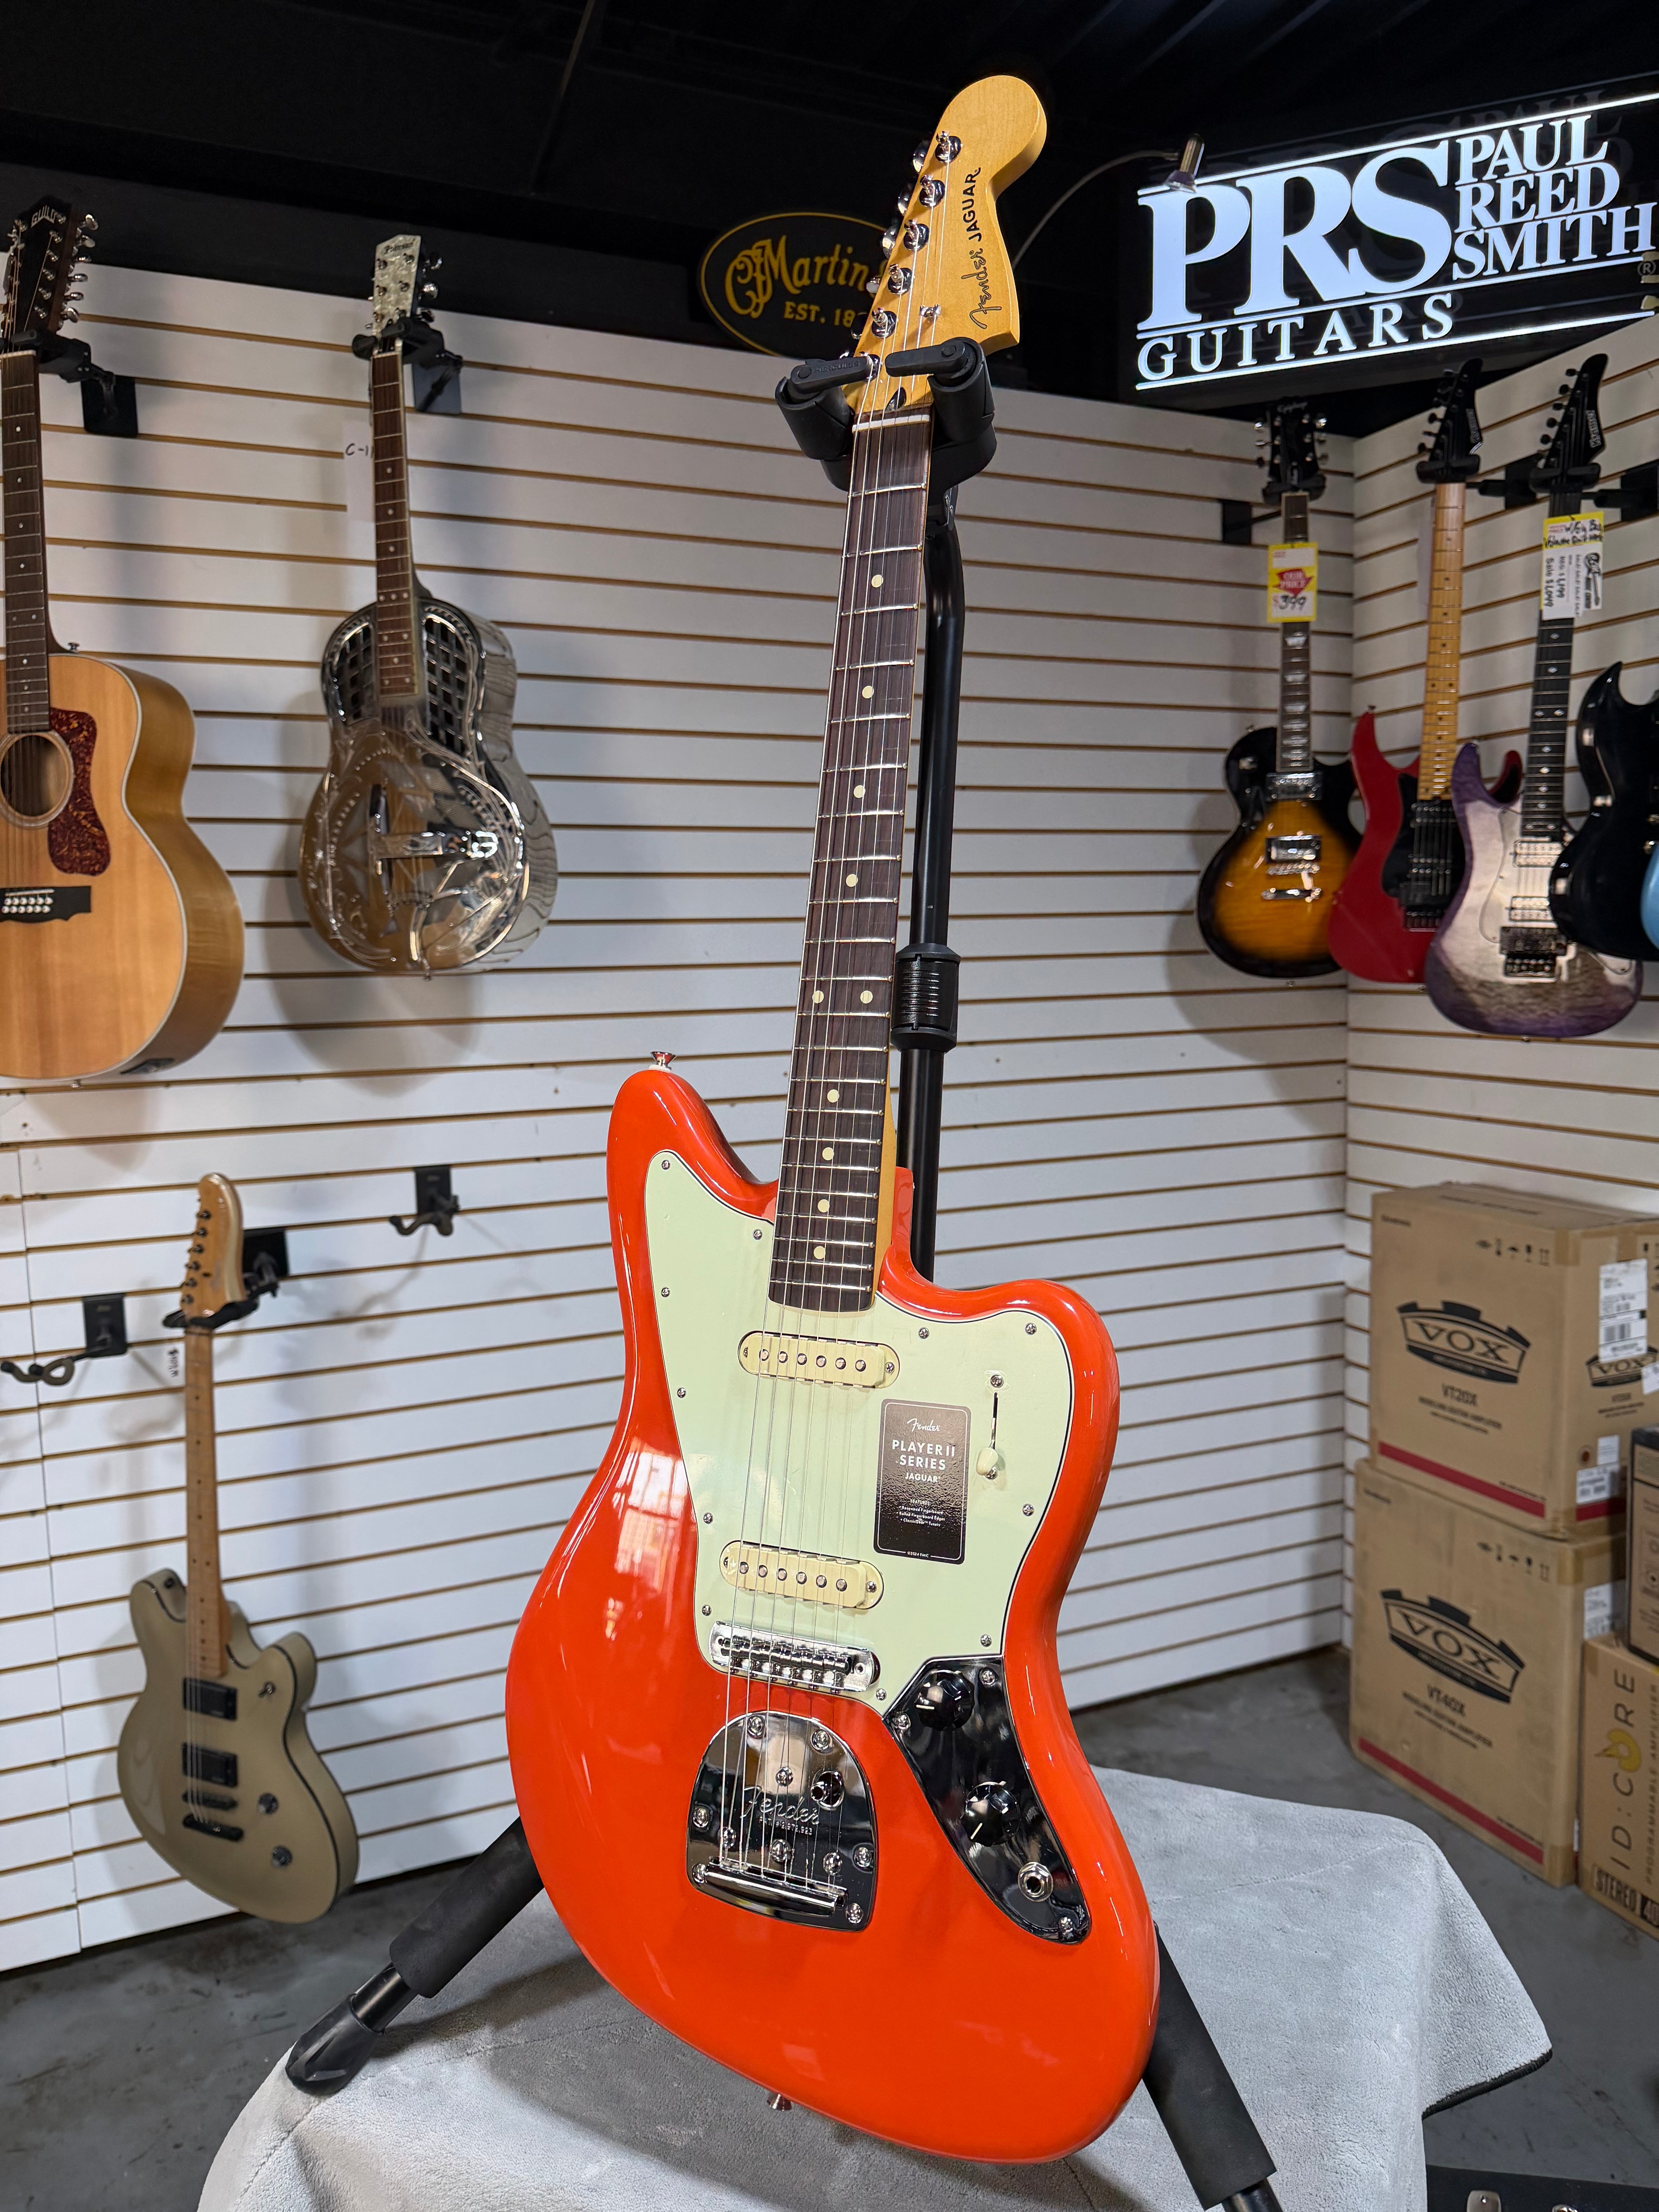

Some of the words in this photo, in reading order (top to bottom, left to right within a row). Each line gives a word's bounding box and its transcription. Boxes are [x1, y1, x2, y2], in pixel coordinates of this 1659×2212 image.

[1456, 115, 1609, 187] PAUL
[31, 205, 58, 228] GUILD
[962, 167, 981, 242] JAGUAR
[1455, 161, 1620, 232] REED
[1137, 140, 1451, 330] PRS
[1452, 202, 1657, 281] SMITH
[783, 301, 826, 323] EST.
[961, 248, 1001, 329] Fender
[1137, 293, 1453, 381] GUITARS
[1413, 1320, 1510, 1364] VOX
[892, 1439, 943, 1456] PLAYER
[907, 1418, 940, 1432] Fender
[899, 1454, 946, 1470] SERIES
[905, 1472, 939, 1483] JAGUAR
[1395, 1609, 1501, 1681] VOX
[740, 1785, 819, 1825] Fender
